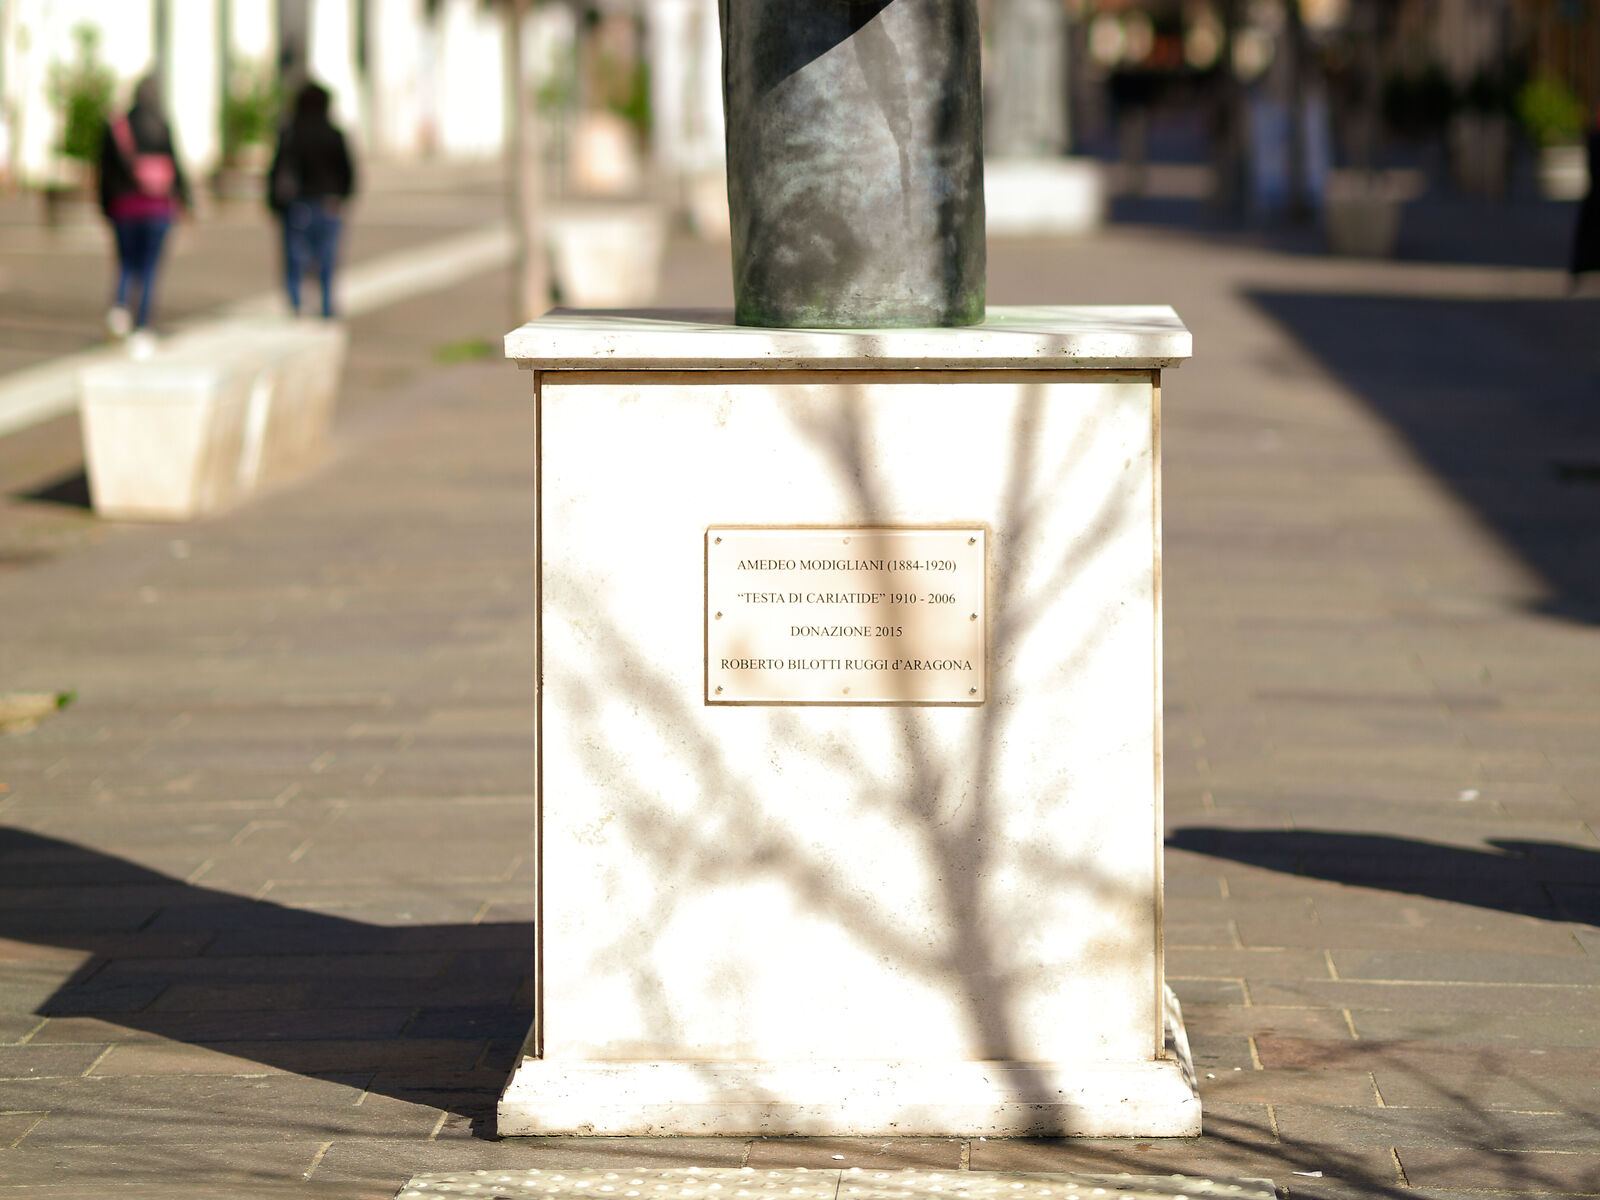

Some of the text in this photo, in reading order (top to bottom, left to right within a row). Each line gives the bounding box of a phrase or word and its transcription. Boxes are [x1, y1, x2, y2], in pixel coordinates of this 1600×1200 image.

[737, 559, 957, 573] AMEDEO MODIGLIANI (1884-1920)
[789, 593, 802, 604] DI
[889, 593, 916, 604] 1910
[928, 593, 956, 604] 2006
[790, 626, 903, 637] DONAZIONE 2015
[721, 659, 784, 670] ROBERTO
[788, 659, 841, 670] BILOTTI
[845, 659, 888, 670] RUGGI
